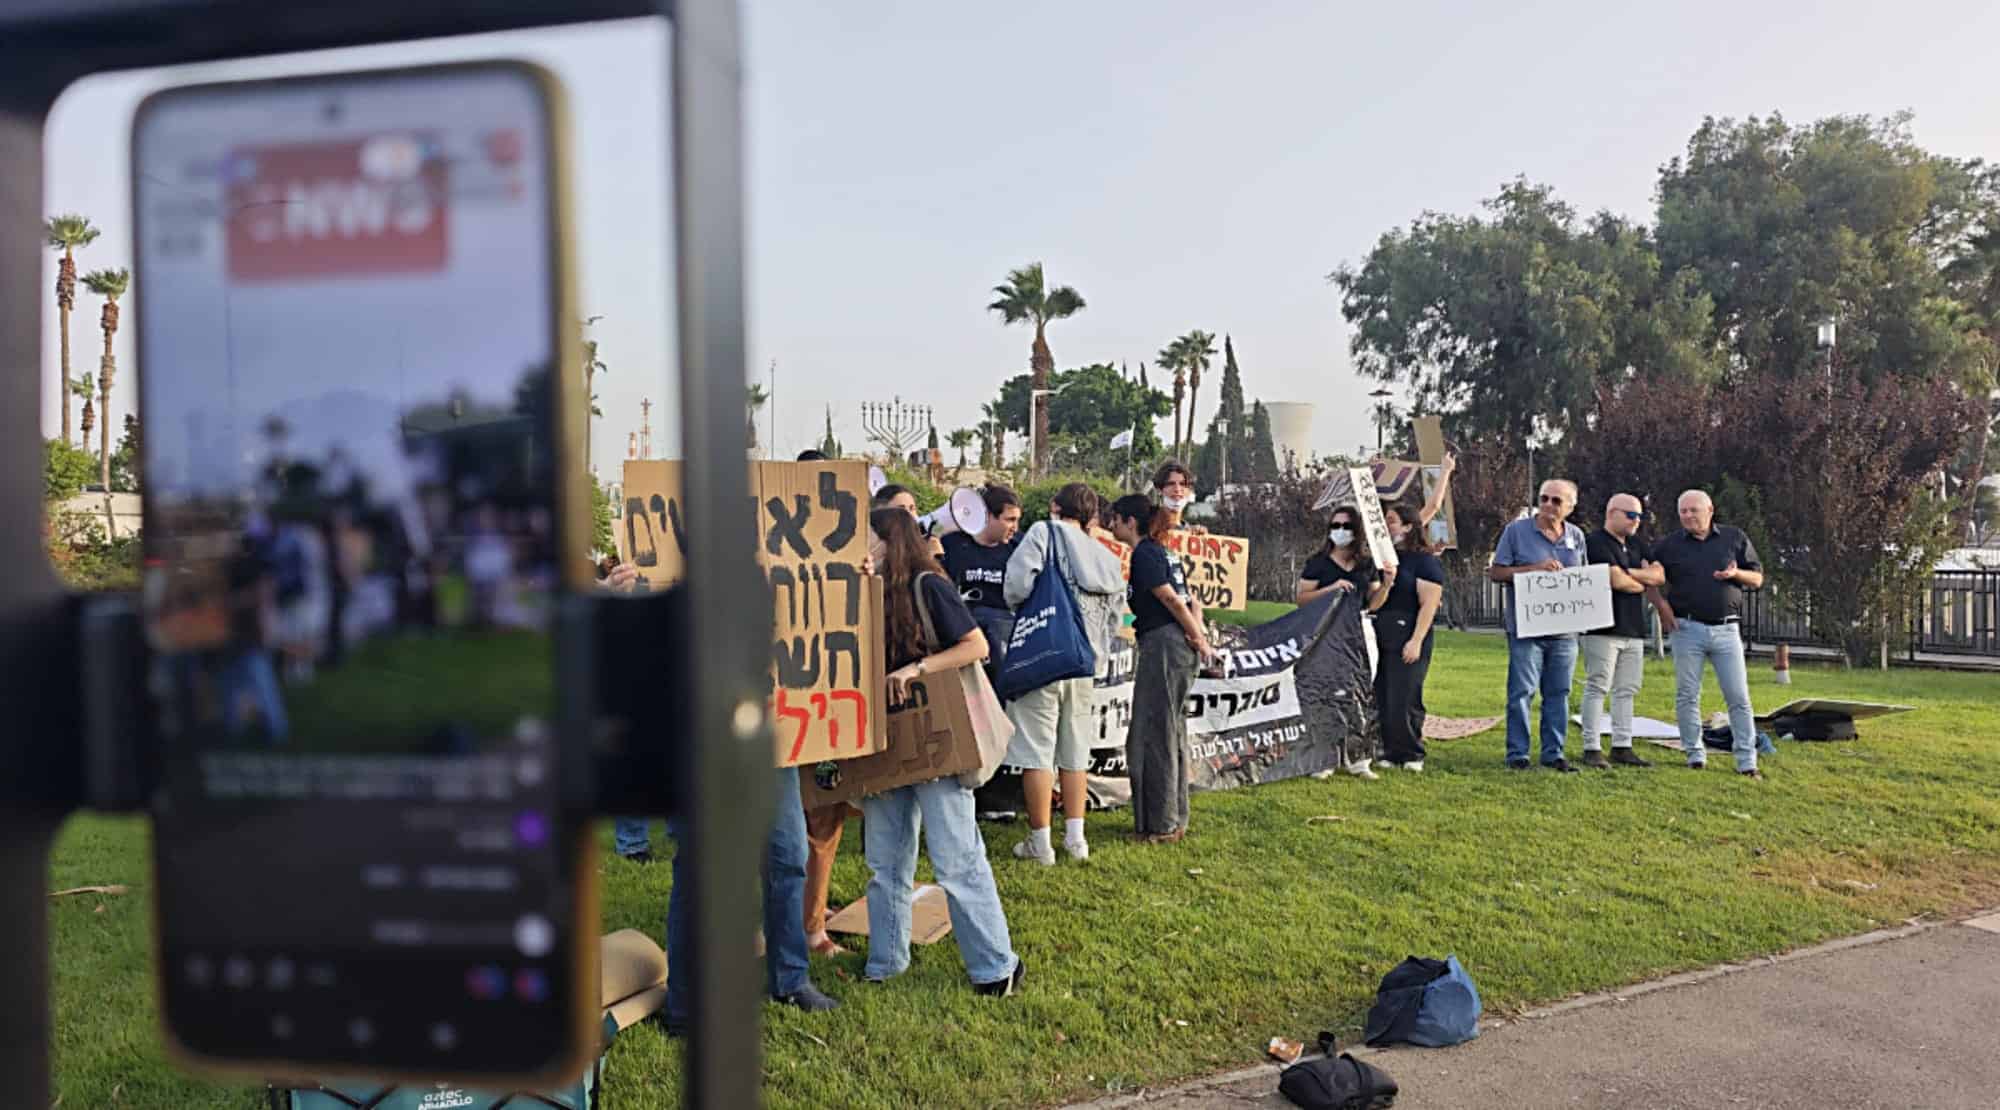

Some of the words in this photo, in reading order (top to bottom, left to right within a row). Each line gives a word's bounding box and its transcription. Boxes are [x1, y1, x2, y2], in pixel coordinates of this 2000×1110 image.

[766, 471, 857, 559] לא
[1235, 637, 1303, 670] איום
[1247, 723, 1306, 747] ישראל
